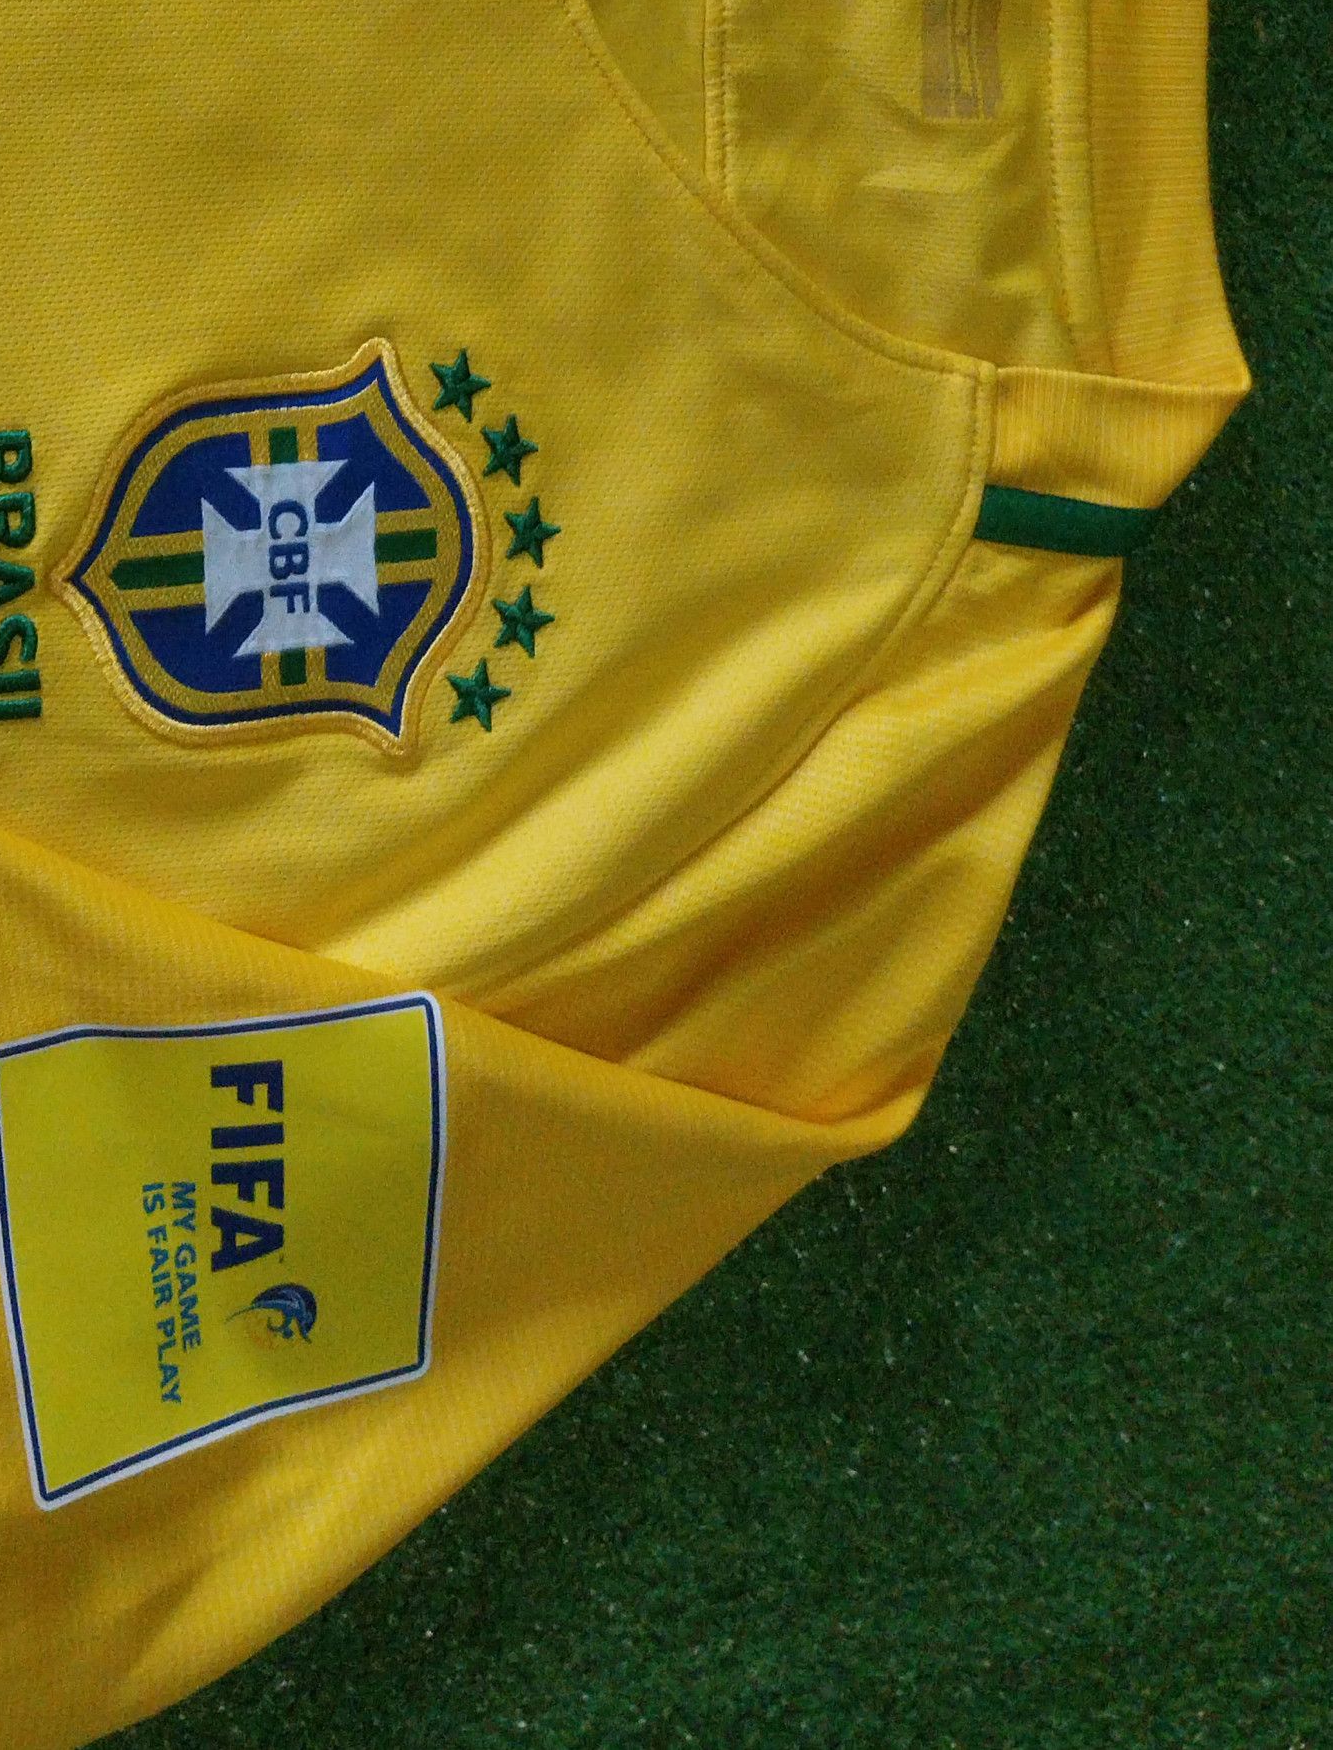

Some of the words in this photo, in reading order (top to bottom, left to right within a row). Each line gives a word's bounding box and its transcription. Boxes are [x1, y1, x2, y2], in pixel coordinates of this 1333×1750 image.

[267, 499, 312, 615] CBF
[142, 1182, 167, 1216] IS
[170, 1182, 195, 1235] MY
[211, 1060, 284, 1273] FIFA
[146, 1225, 175, 1308] FAIR
[175, 1243, 201, 1353] GAME
[153, 1317, 182, 1405] PLAY
